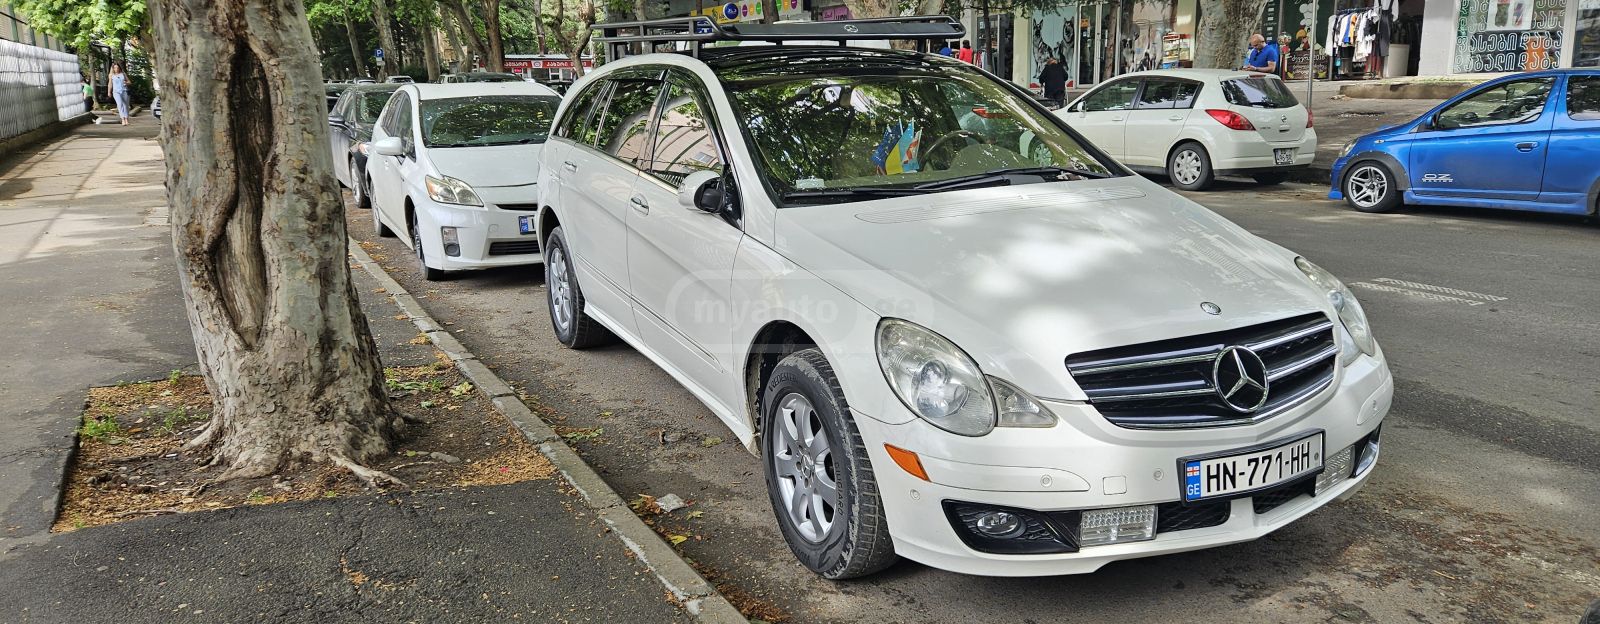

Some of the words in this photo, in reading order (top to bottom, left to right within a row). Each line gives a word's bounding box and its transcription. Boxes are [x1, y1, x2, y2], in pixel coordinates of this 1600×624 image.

[1457, 33, 1517, 53] ფასები
[1455, 52, 1515, 73] დაბალი
[1206, 441, 1311, 493] HN-771-HH
[1187, 483, 1201, 496] GE
